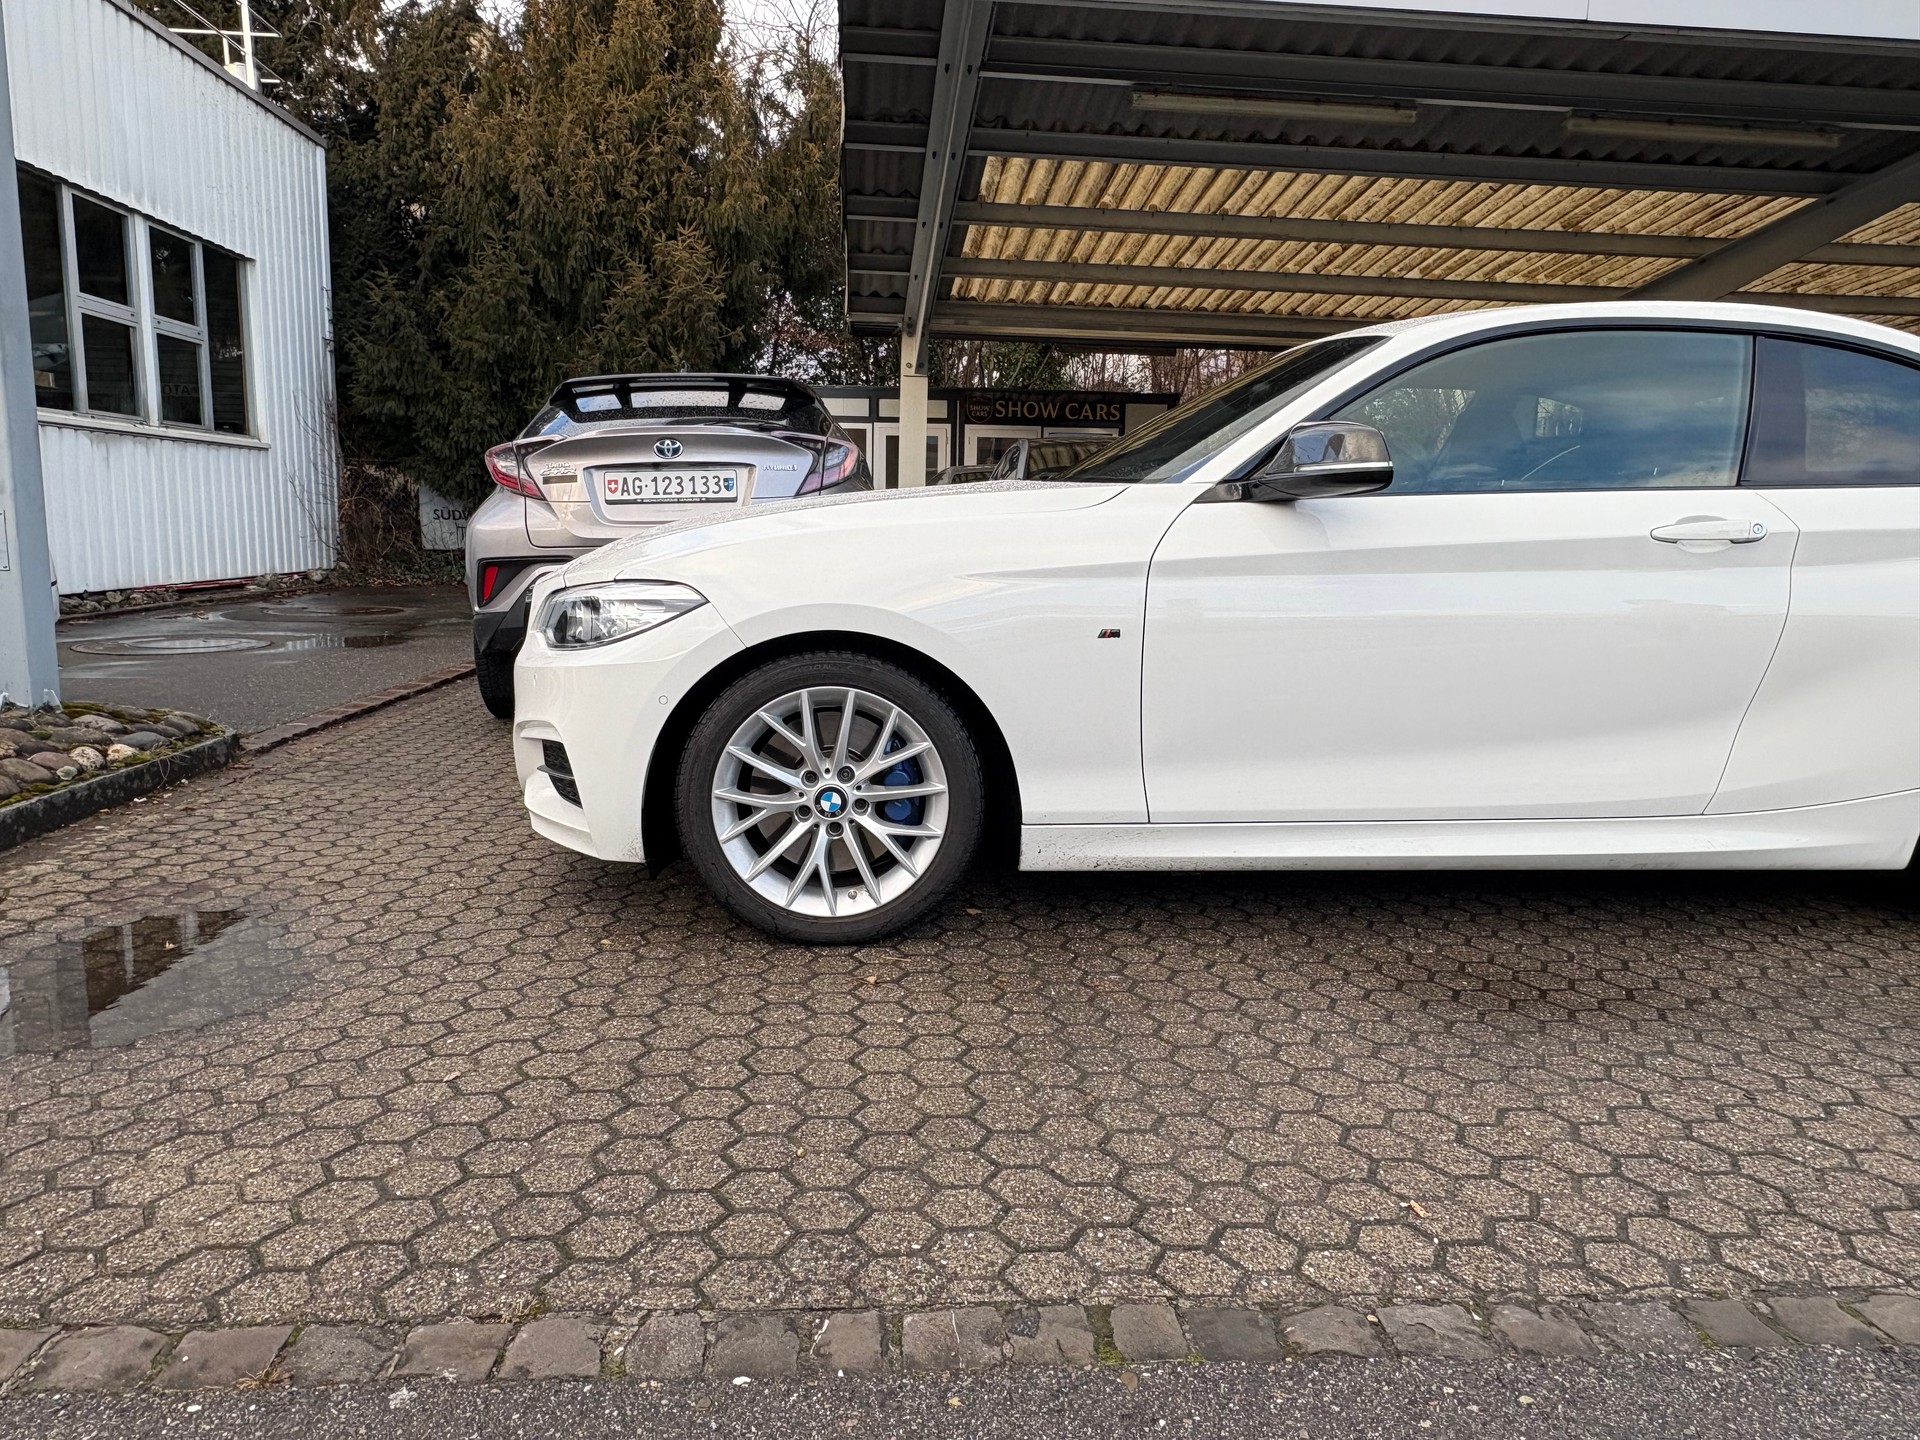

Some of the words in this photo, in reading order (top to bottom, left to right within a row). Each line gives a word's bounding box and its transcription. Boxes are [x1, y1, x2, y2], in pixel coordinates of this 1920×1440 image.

[969, 404, 990, 412] SHOW
[995, 400, 1060, 419] SHOW
[1065, 403, 1120, 421] CARS
